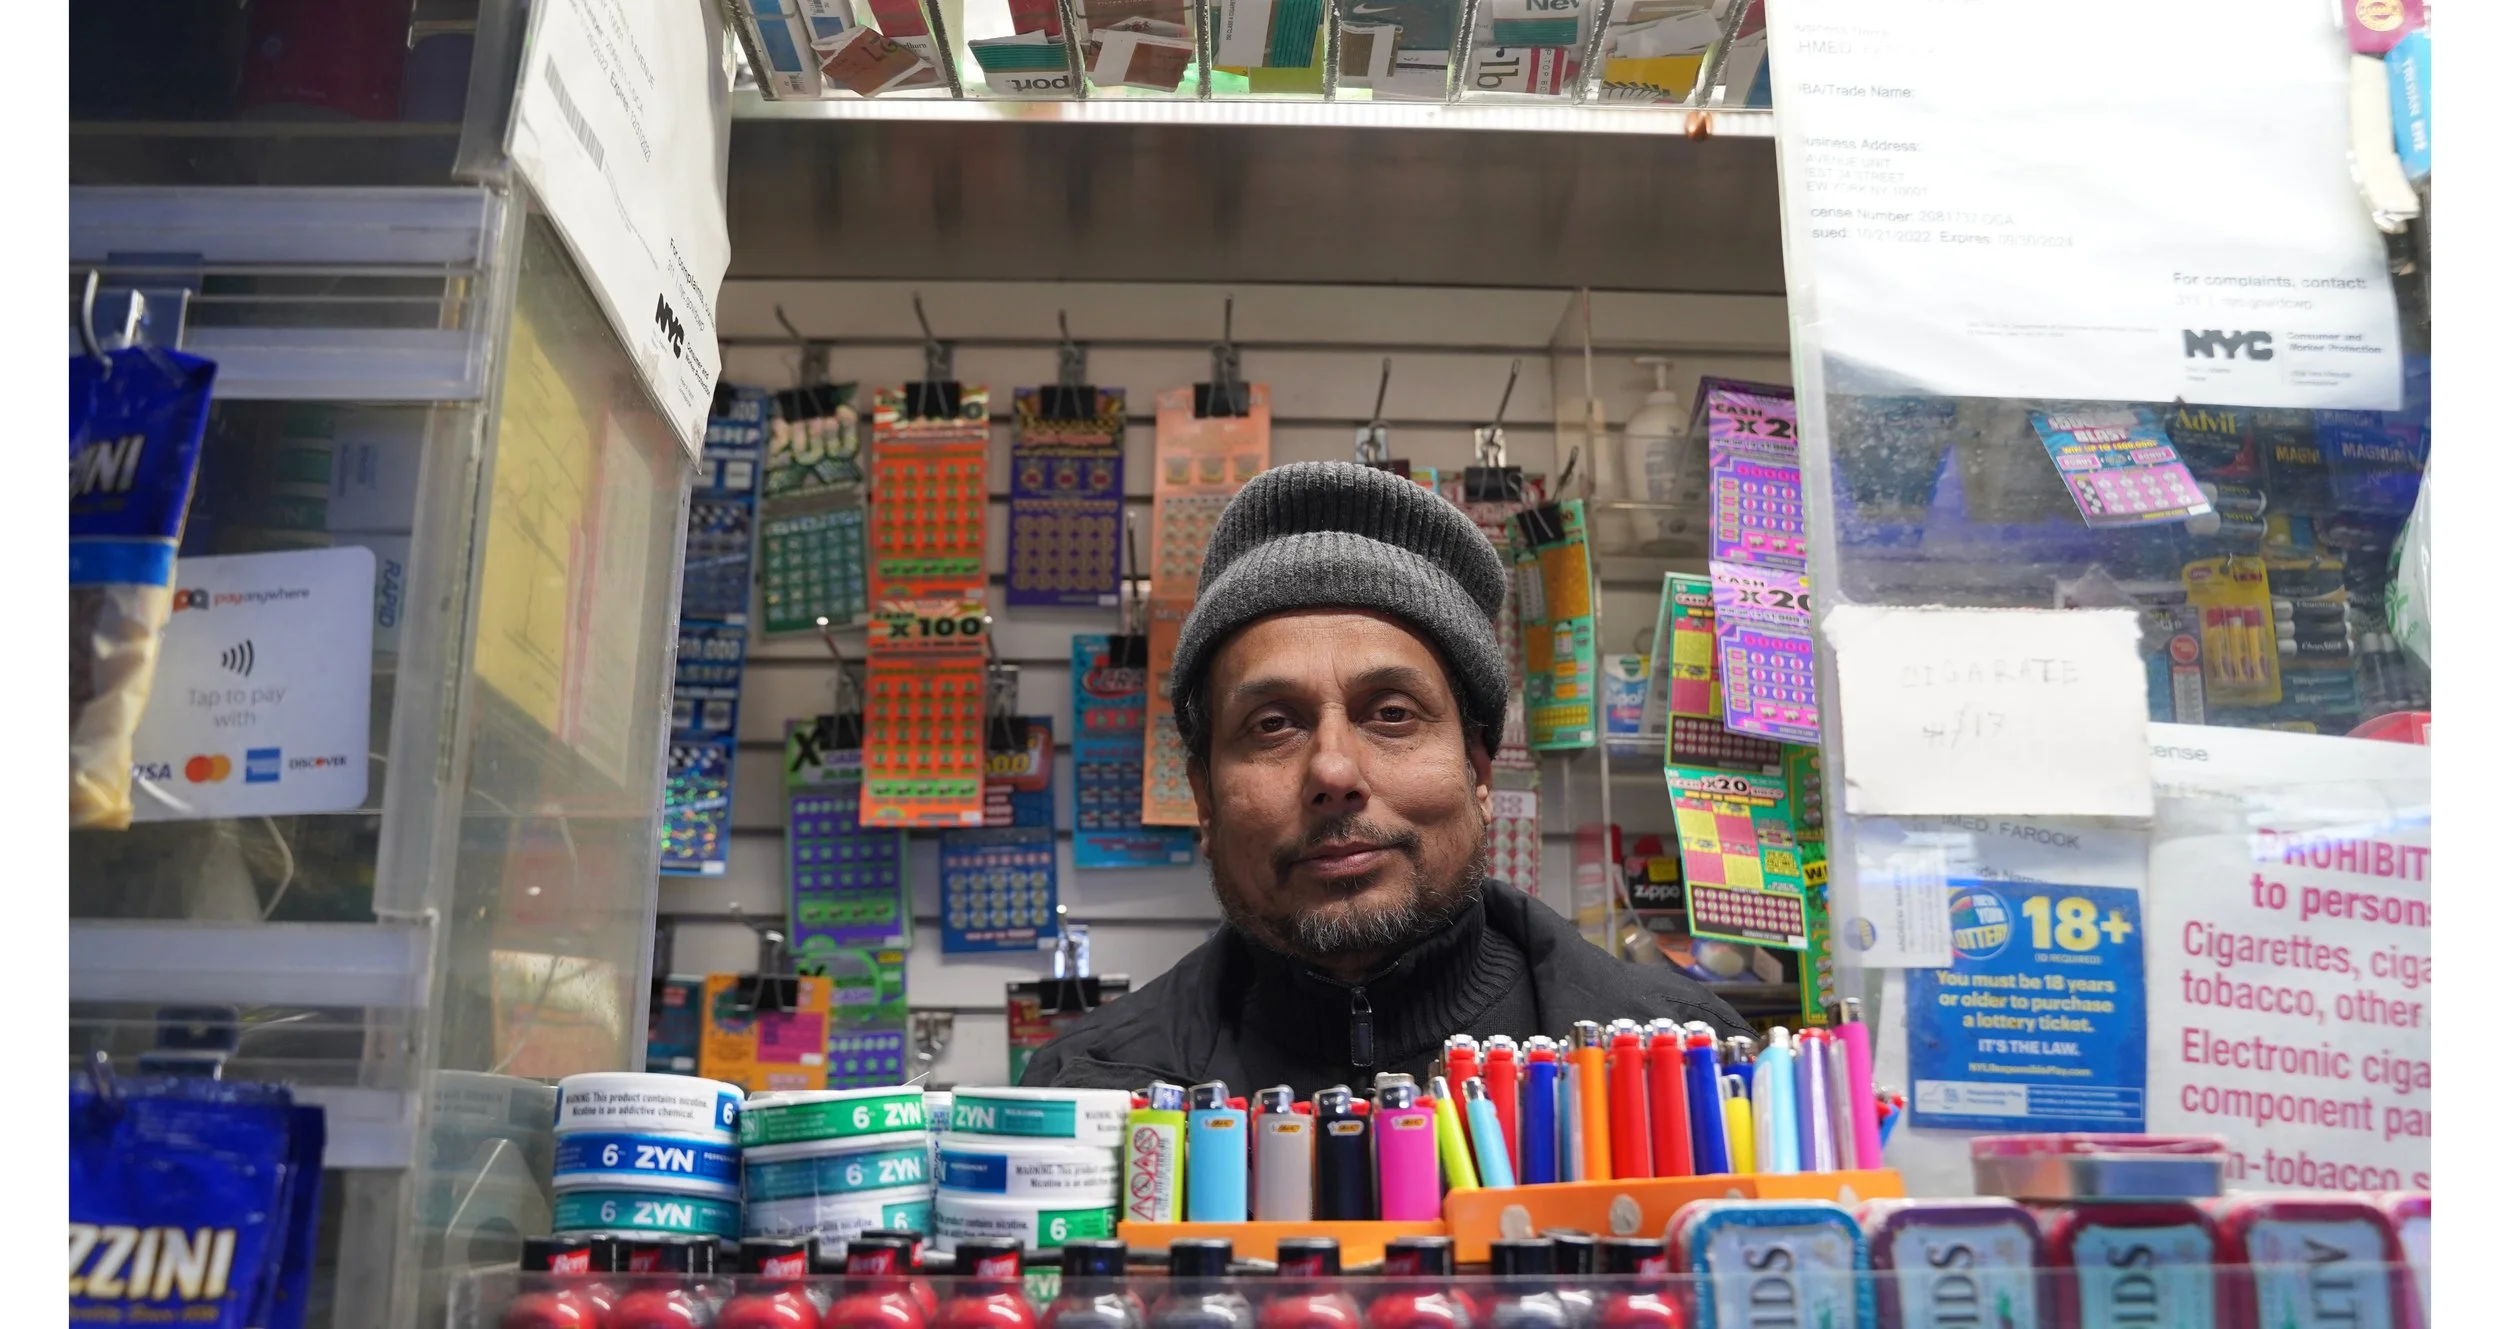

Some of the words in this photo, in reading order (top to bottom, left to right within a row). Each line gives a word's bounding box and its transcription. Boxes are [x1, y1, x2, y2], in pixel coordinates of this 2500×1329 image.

[2173, 272, 2199, 286] For
[655, 292, 685, 360] NYC
[2181, 329, 2273, 361] NYC
[1716, 403, 1763, 417] CASH
[2175, 408, 2237, 435] Advil
[378, 559, 401, 628] RAPID
[1718, 575, 1765, 588] CASH
[214, 587, 310, 607] payanywhere
[188, 688, 221, 708] Tap
[227, 688, 246, 706] to
[251, 686, 286, 708] pay
[213, 709, 256, 728] with
[1999, 821, 2080, 849] FAROOK
[2250, 873, 2287, 910] to
[2022, 895, 2133, 952] 18+
[2183, 920, 2362, 981] Cigarettes,
[1936, 970, 1969, 987] You
[1972, 973, 2016, 989] must
[2018, 972, 2042, 989] be
[2044, 974, 2065, 991] 18
[2067, 978, 2116, 994] years
[1938, 993, 1959, 1006] or
[1960, 991, 2007, 1008] older
[2010, 994, 2029, 1009] to
[2031, 996, 2115, 1013] purchase
[2181, 969, 2326, 1026] tobacco,
[2336, 989, 2423, 1028] other
[1962, 1013, 1974, 1028] a
[1976, 1011, 2036, 1033] lottery
[2038, 1014, 2095, 1033] ticket.
[1978, 1038, 2007, 1053] IT'S
[2009, 1039, 2040, 1055] THE
[2181, 1026, 2352, 1081] Electronic
[852, 1105, 870, 1130] 6
[884, 1101, 922, 1127] ZYN
[955, 1103, 996, 1129] ZYN
[2181, 1083, 2374, 1133] component
[602, 1143, 619, 1167] 6
[634, 1144, 695, 1173] ZYN
[845, 1163, 864, 1187] 6
[878, 1157, 922, 1184] ZYN
[601, 1200, 617, 1224] 6
[633, 1201, 693, 1229] ZYN
[1050, 1216, 1067, 1241] 6
